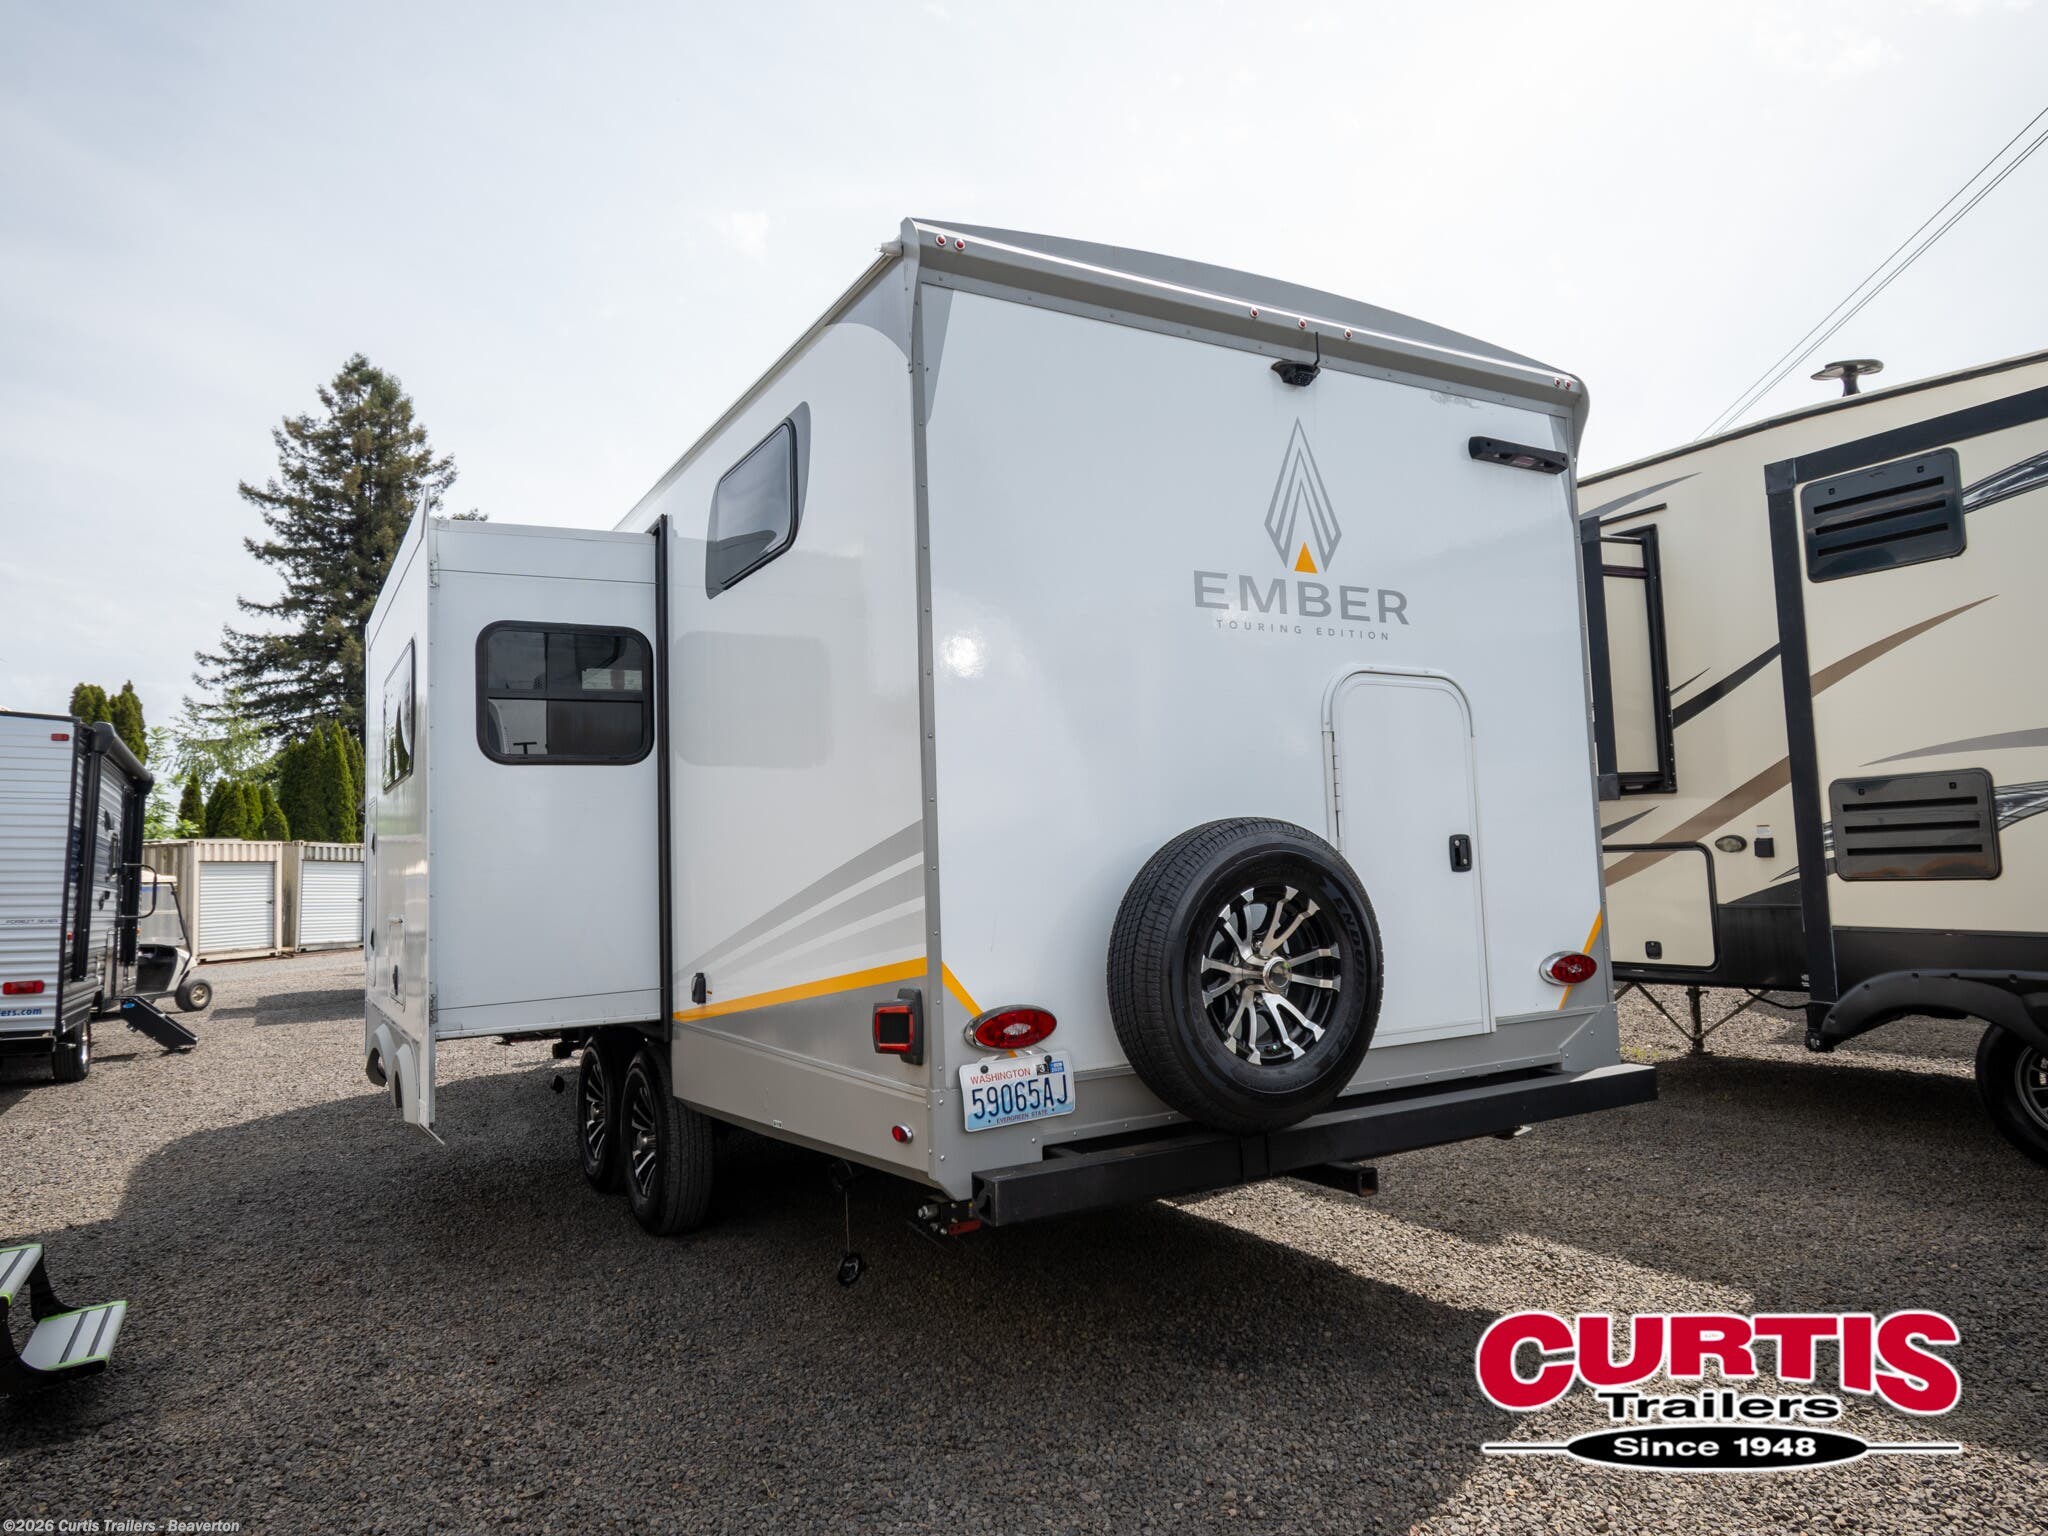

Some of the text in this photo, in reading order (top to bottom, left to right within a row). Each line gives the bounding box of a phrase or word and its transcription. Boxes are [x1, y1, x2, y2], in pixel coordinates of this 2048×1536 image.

[1193, 570, 1411, 625] EMBER
[1216, 619, 1389, 640] TOURING EDITION
[970, 1068, 1031, 1084] WASHINGTON
[972, 1074, 1068, 1119] 59065AJ
[996, 1109, 1048, 1125] EVERGREEN STATE
